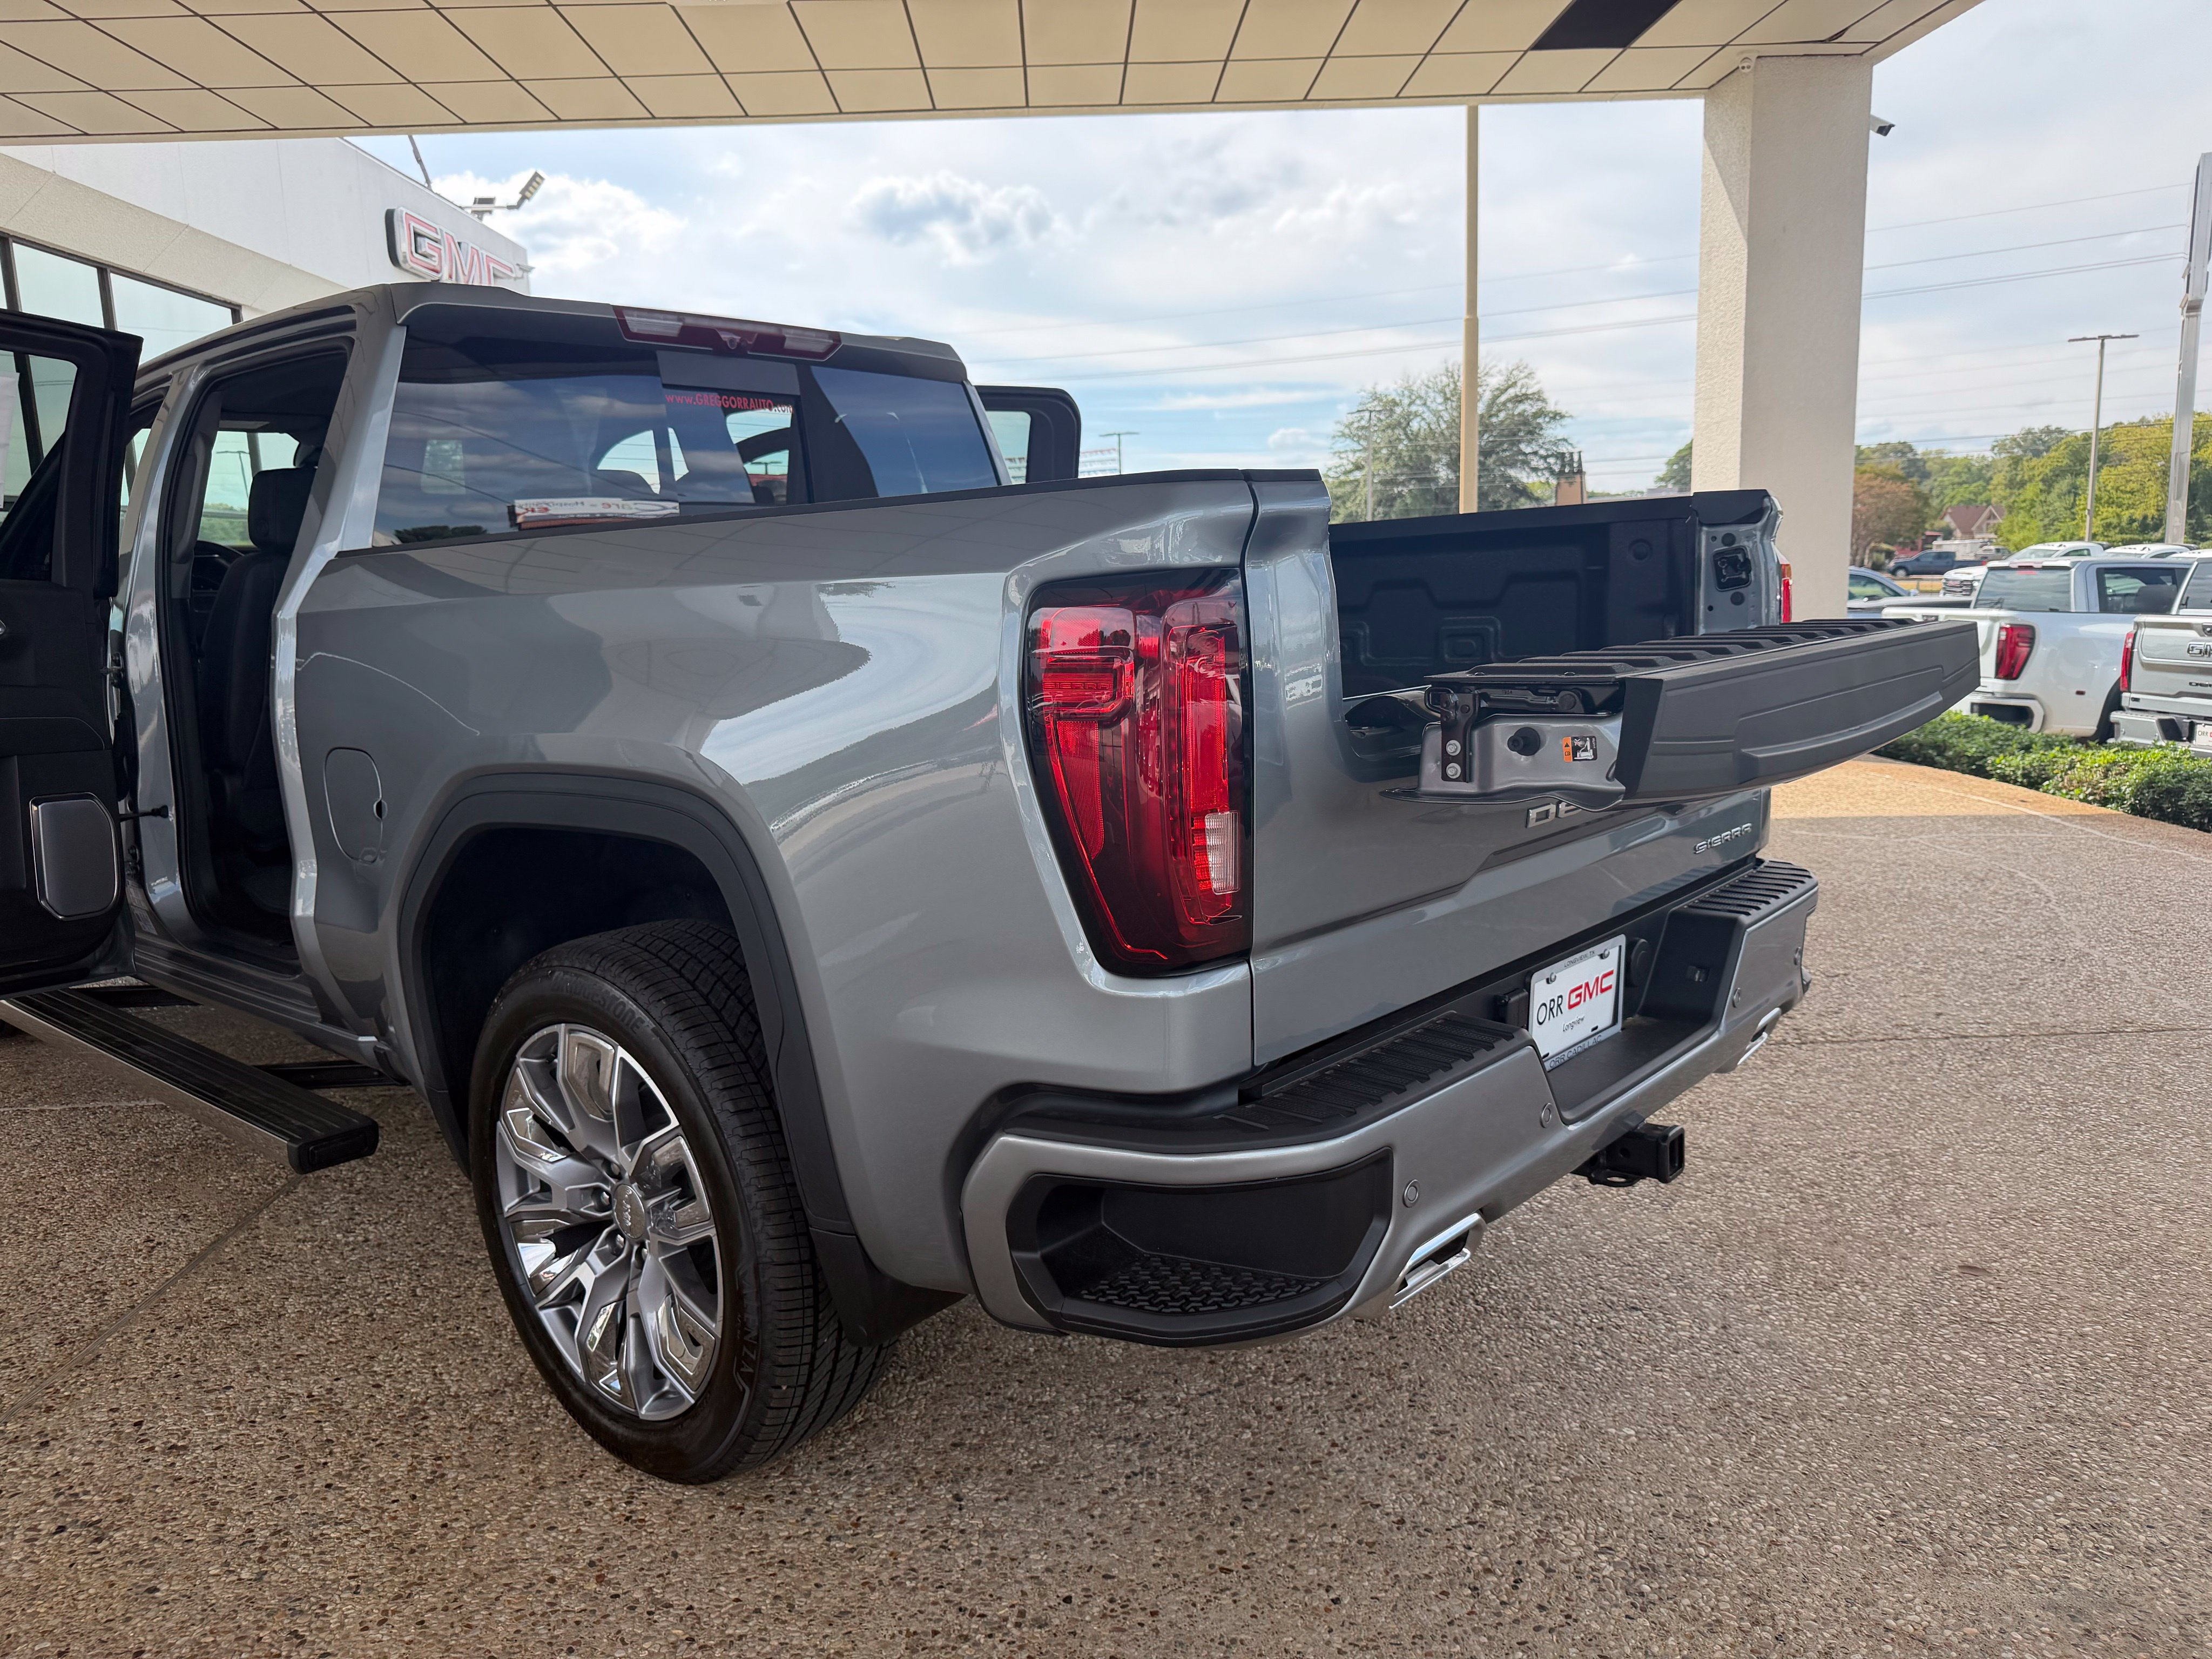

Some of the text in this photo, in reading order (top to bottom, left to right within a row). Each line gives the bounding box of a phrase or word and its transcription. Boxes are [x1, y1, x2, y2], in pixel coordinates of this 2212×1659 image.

[1694, 823, 1752, 854] SIERRA
[1536, 969, 1614, 1026] ORR GMC
[1562, 1015, 1585, 1033] Longview
[1549, 1035, 1602, 1069] ORR CADILLAC
